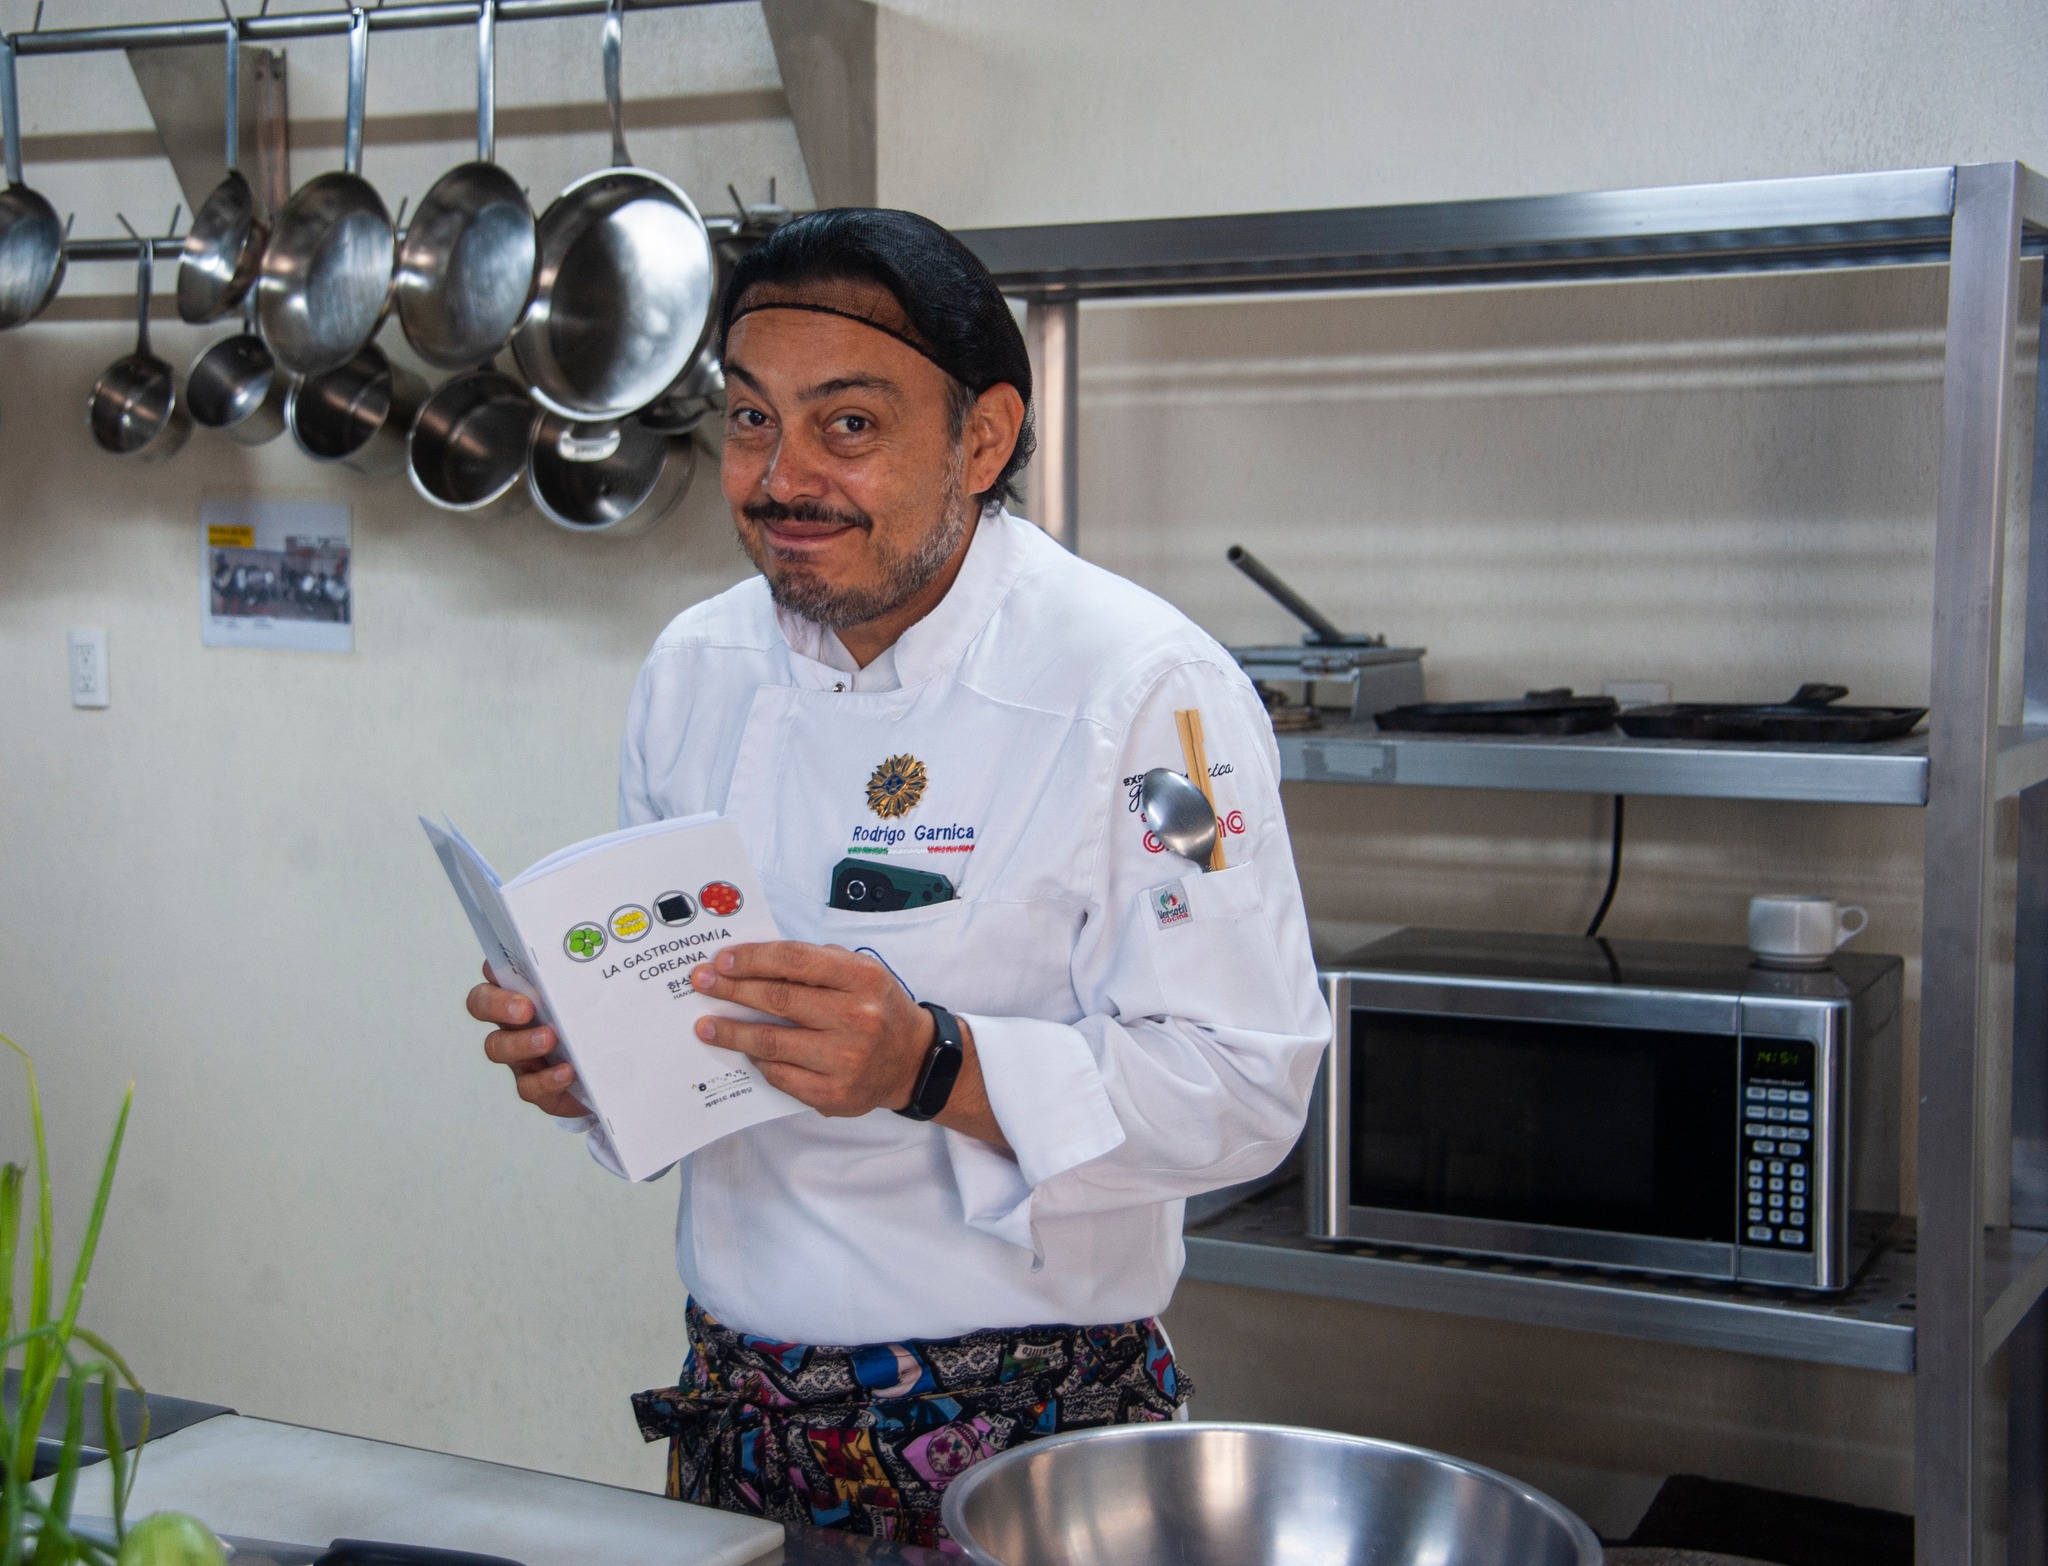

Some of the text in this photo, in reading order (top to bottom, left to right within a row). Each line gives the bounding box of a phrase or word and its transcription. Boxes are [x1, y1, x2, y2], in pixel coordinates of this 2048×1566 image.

[853, 823, 974, 845] Rodrigo Garnica
[1161, 912, 1189, 924] cocina
[602, 928, 732, 979] LA GASTRONOMÍA
[639, 951, 708, 981] COREANA
[1022, 1345, 1056, 1357] Gallito
